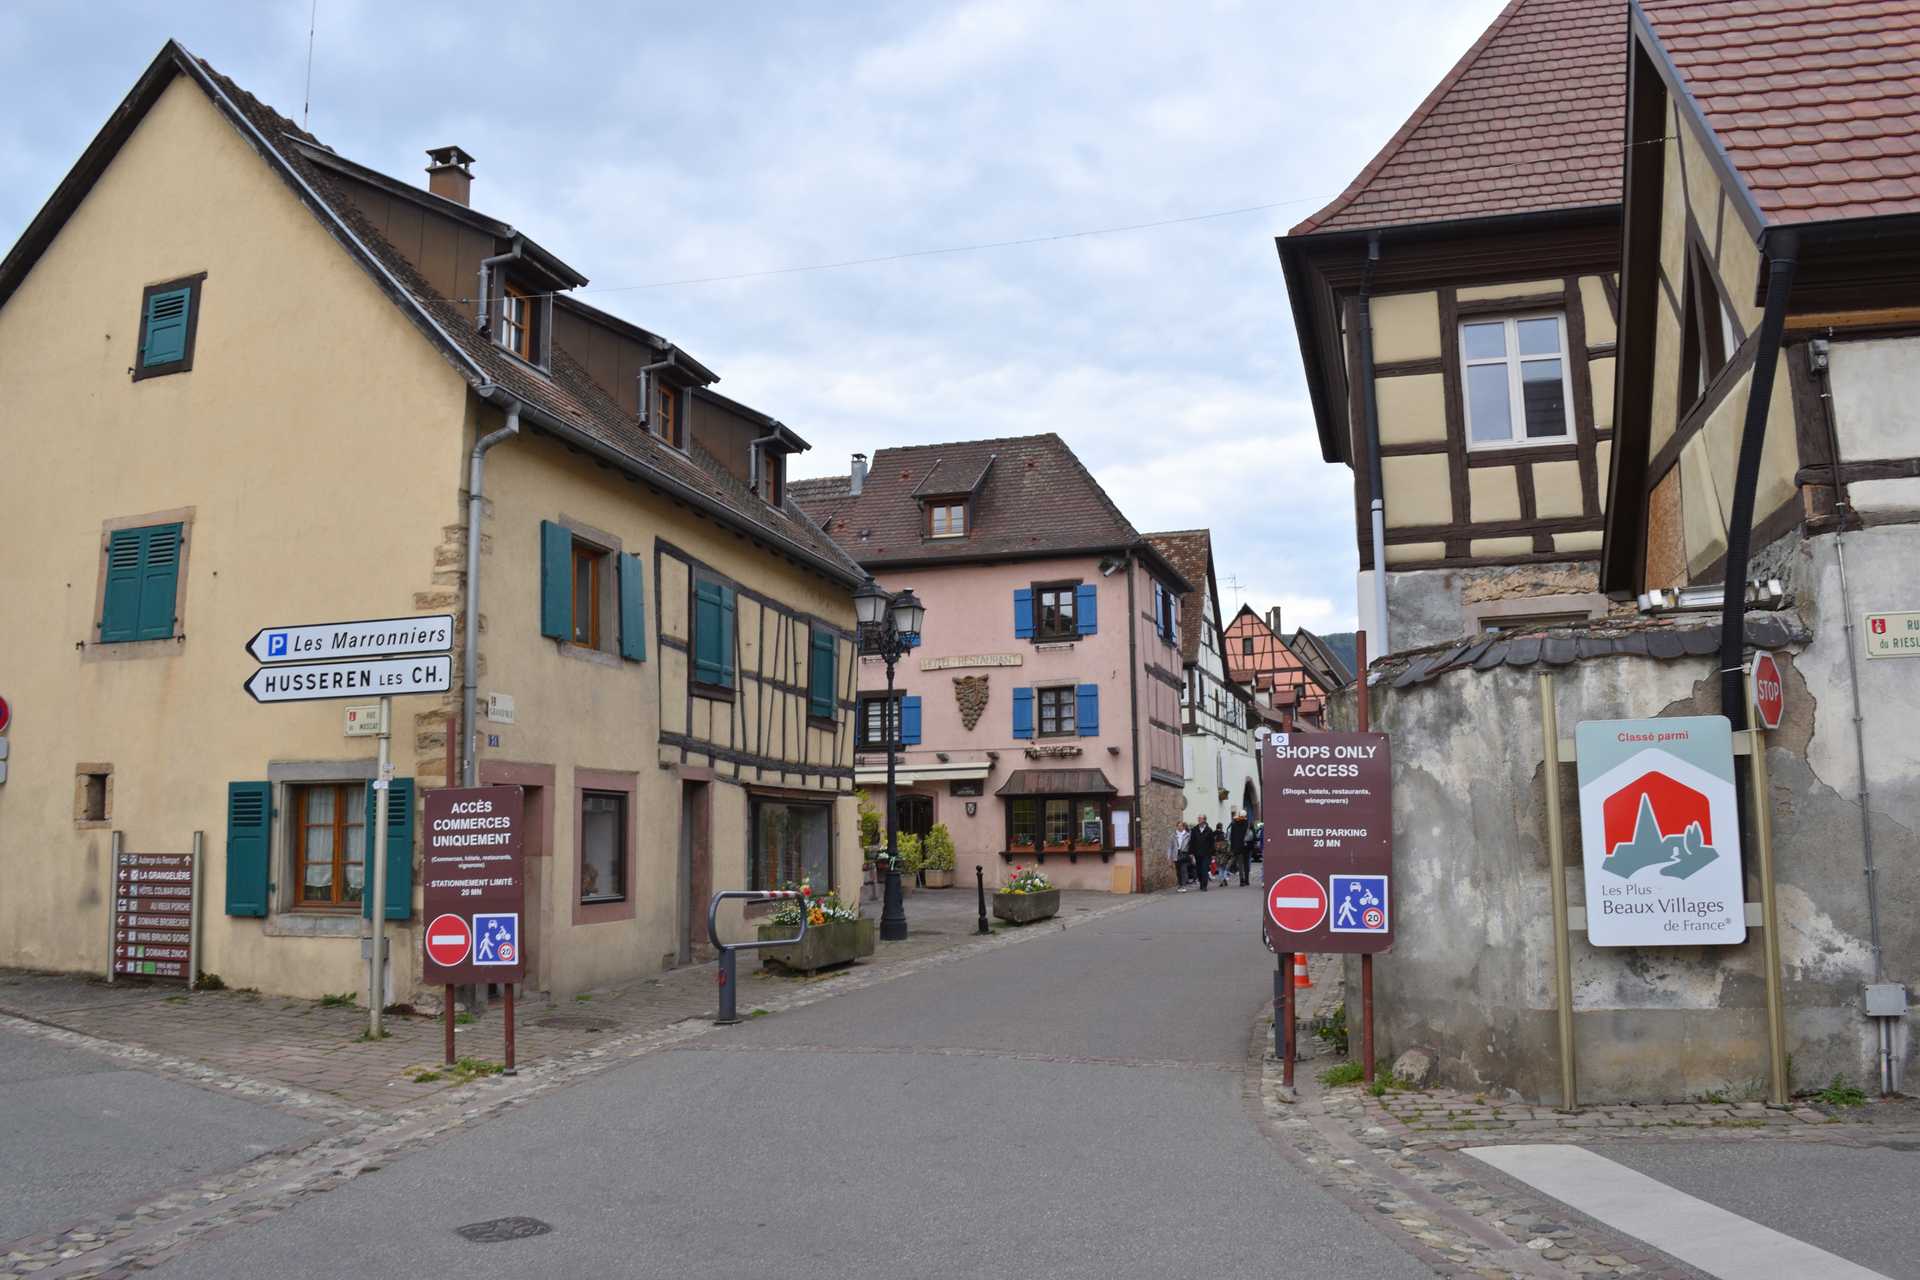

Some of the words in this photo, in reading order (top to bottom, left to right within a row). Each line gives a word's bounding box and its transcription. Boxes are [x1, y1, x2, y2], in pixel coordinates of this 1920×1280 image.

[1907, 619, 1920, 630] RU
[294, 635, 322, 652] Les
[332, 627, 446, 649] Marronniers
[1880, 639, 1889, 649] du
[1892, 637, 1920, 649] RIESL
[265, 670, 371, 693] HUSSEREN
[379, 674, 403, 686] LES
[412, 666, 443, 684] CH.
[1758, 680, 1779, 701] STOP
[1658, 731, 1689, 743] parmi
[1276, 745, 1330, 759] SHOPS
[1335, 745, 1377, 759] ONLY
[1293, 764, 1359, 777] ACCESS
[1282, 788, 1308, 796] (Shops,
[1309, 788, 1331, 796] hotels,
[1332, 788, 1372, 796] restaurants,
[451, 799, 493, 814] ACCÈS
[433, 816, 511, 831] COMMERCES
[1287, 828, 1324, 837] LIMITED
[1326, 828, 1368, 837] PARKING
[432, 832, 512, 847] UNIQUEMENT
[1313, 839, 1325, 848] 20
[1326, 839, 1341, 848] MN
[139, 871, 148, 880] LA
[431, 878, 489, 888] STATIONNEMENT
[489, 877, 513, 887] LIMITÉ
[461, 888, 470, 897] 20
[470, 888, 483, 896] MN
[1601, 884, 1622, 897] Les
[1626, 883, 1653, 896] Plus
[1603, 899, 1655, 915] Beaux
[1658, 897, 1725, 918] Villages
[1663, 919, 1680, 932] de
[137, 932, 151, 943] VINS
[151, 932, 171, 943] BRUNO
[145, 947, 170, 958] DOMAINE
